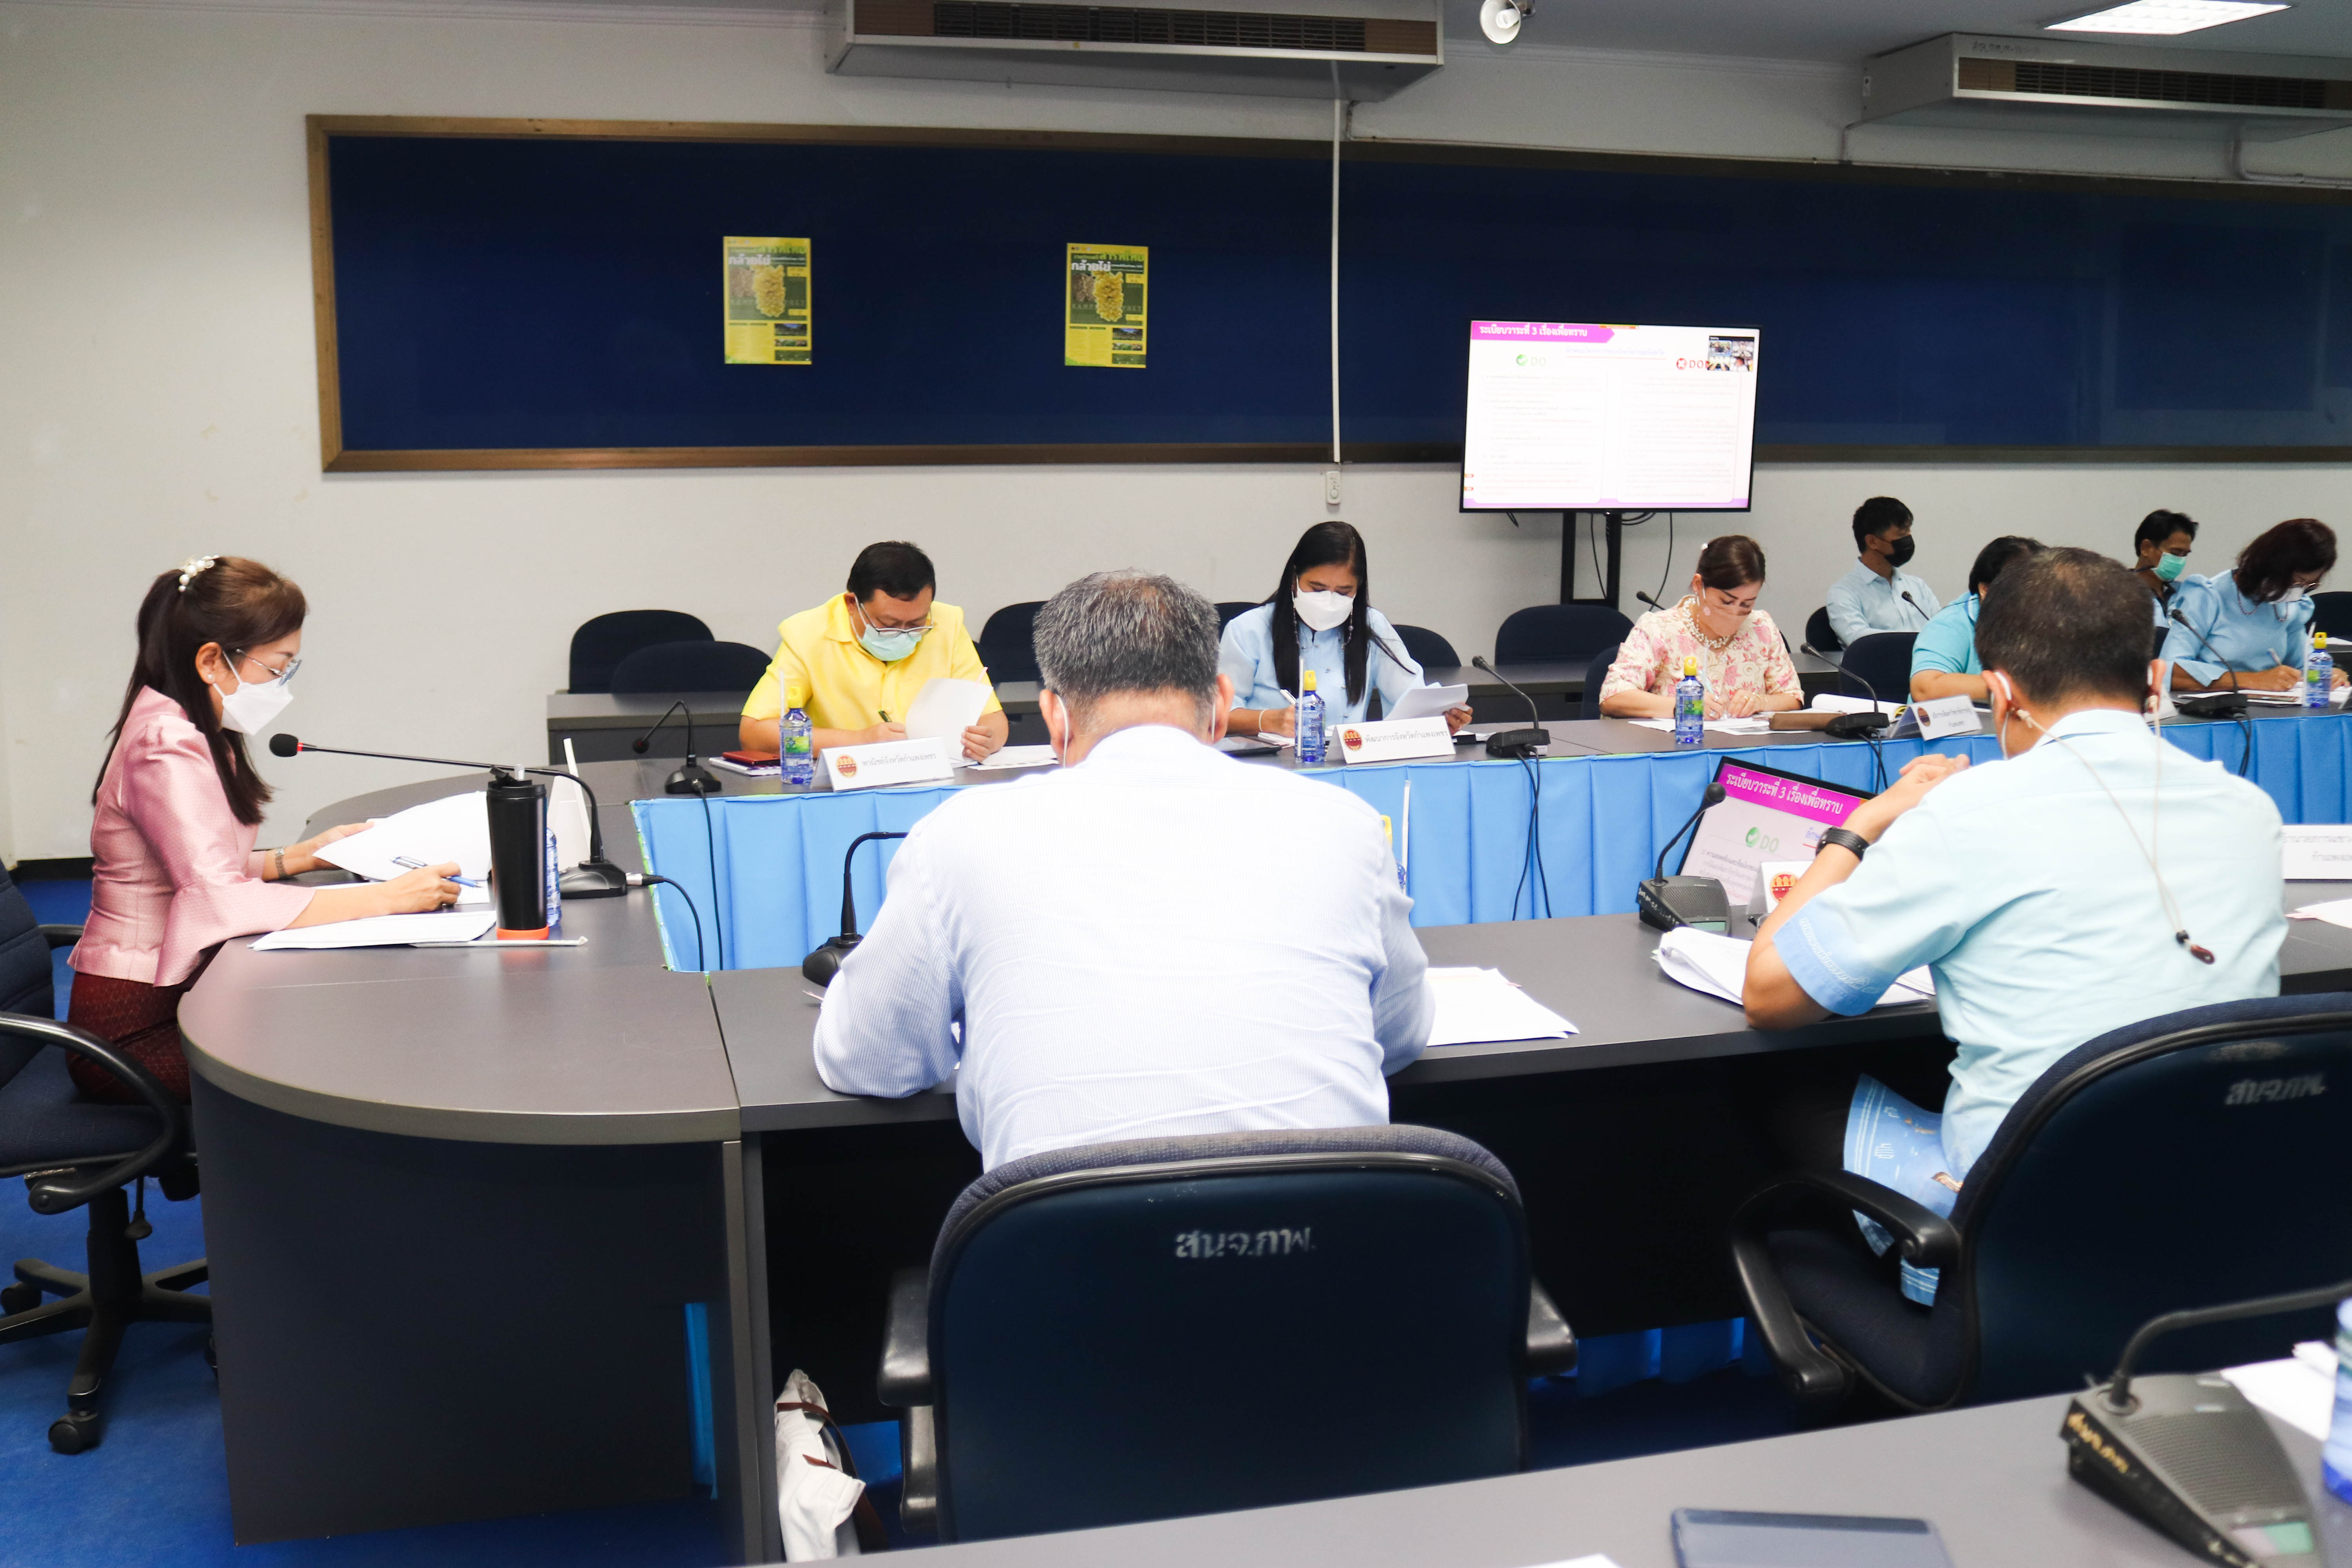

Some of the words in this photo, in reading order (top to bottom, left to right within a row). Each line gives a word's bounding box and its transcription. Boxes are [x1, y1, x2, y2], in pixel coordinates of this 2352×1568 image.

[1479, 323, 1530, 335] ระเบียบวาระที่
[1532, 327, 1537, 336] 3
[1539, 323, 1588, 337] เรื่องเพื่อทราบ
[1530, 357, 1546, 366] DO
[1365, 730, 1448, 743] พัฒนาการจังหวัดกำแพงเพชร
[1726, 772, 1782, 797] ระเบียบวาระที่
[1779, 786, 1786, 799] 3
[1786, 782, 1844, 815] เรื่องเพื่อทราบ
[1760, 835, 1780, 853] DO
